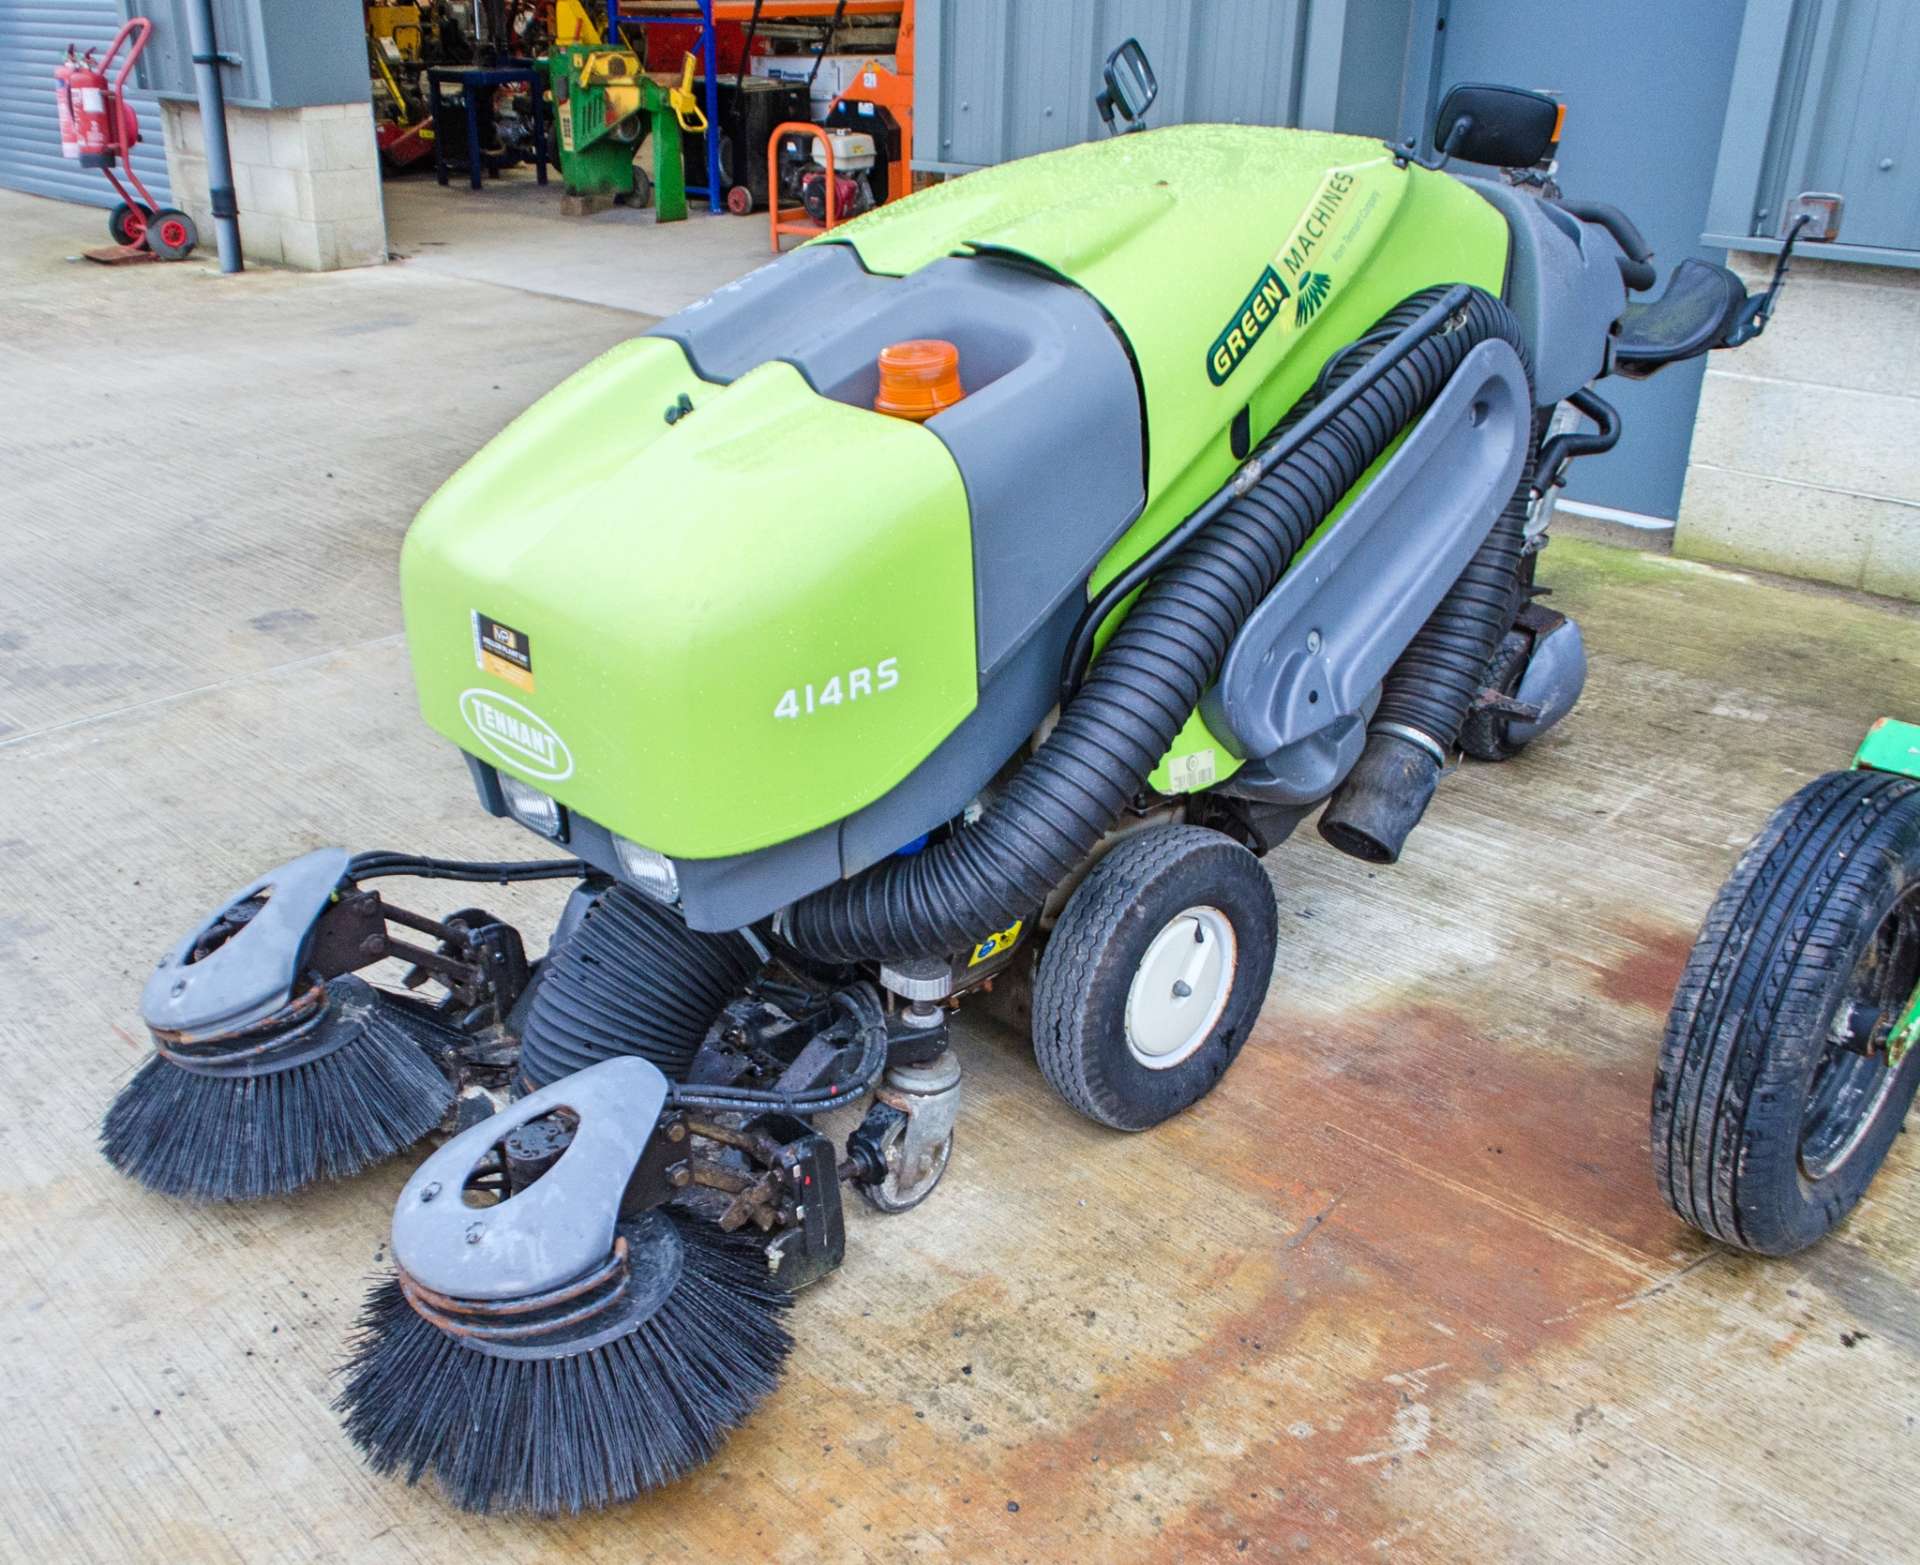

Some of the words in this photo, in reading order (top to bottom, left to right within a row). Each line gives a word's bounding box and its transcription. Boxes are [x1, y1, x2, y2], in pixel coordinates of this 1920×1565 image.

[1213, 277, 1284, 376] GREEN
[1283, 172, 1354, 275] MACHINES
[773, 657, 899, 718] 414RS
[471, 697, 557, 769] TENNANT
